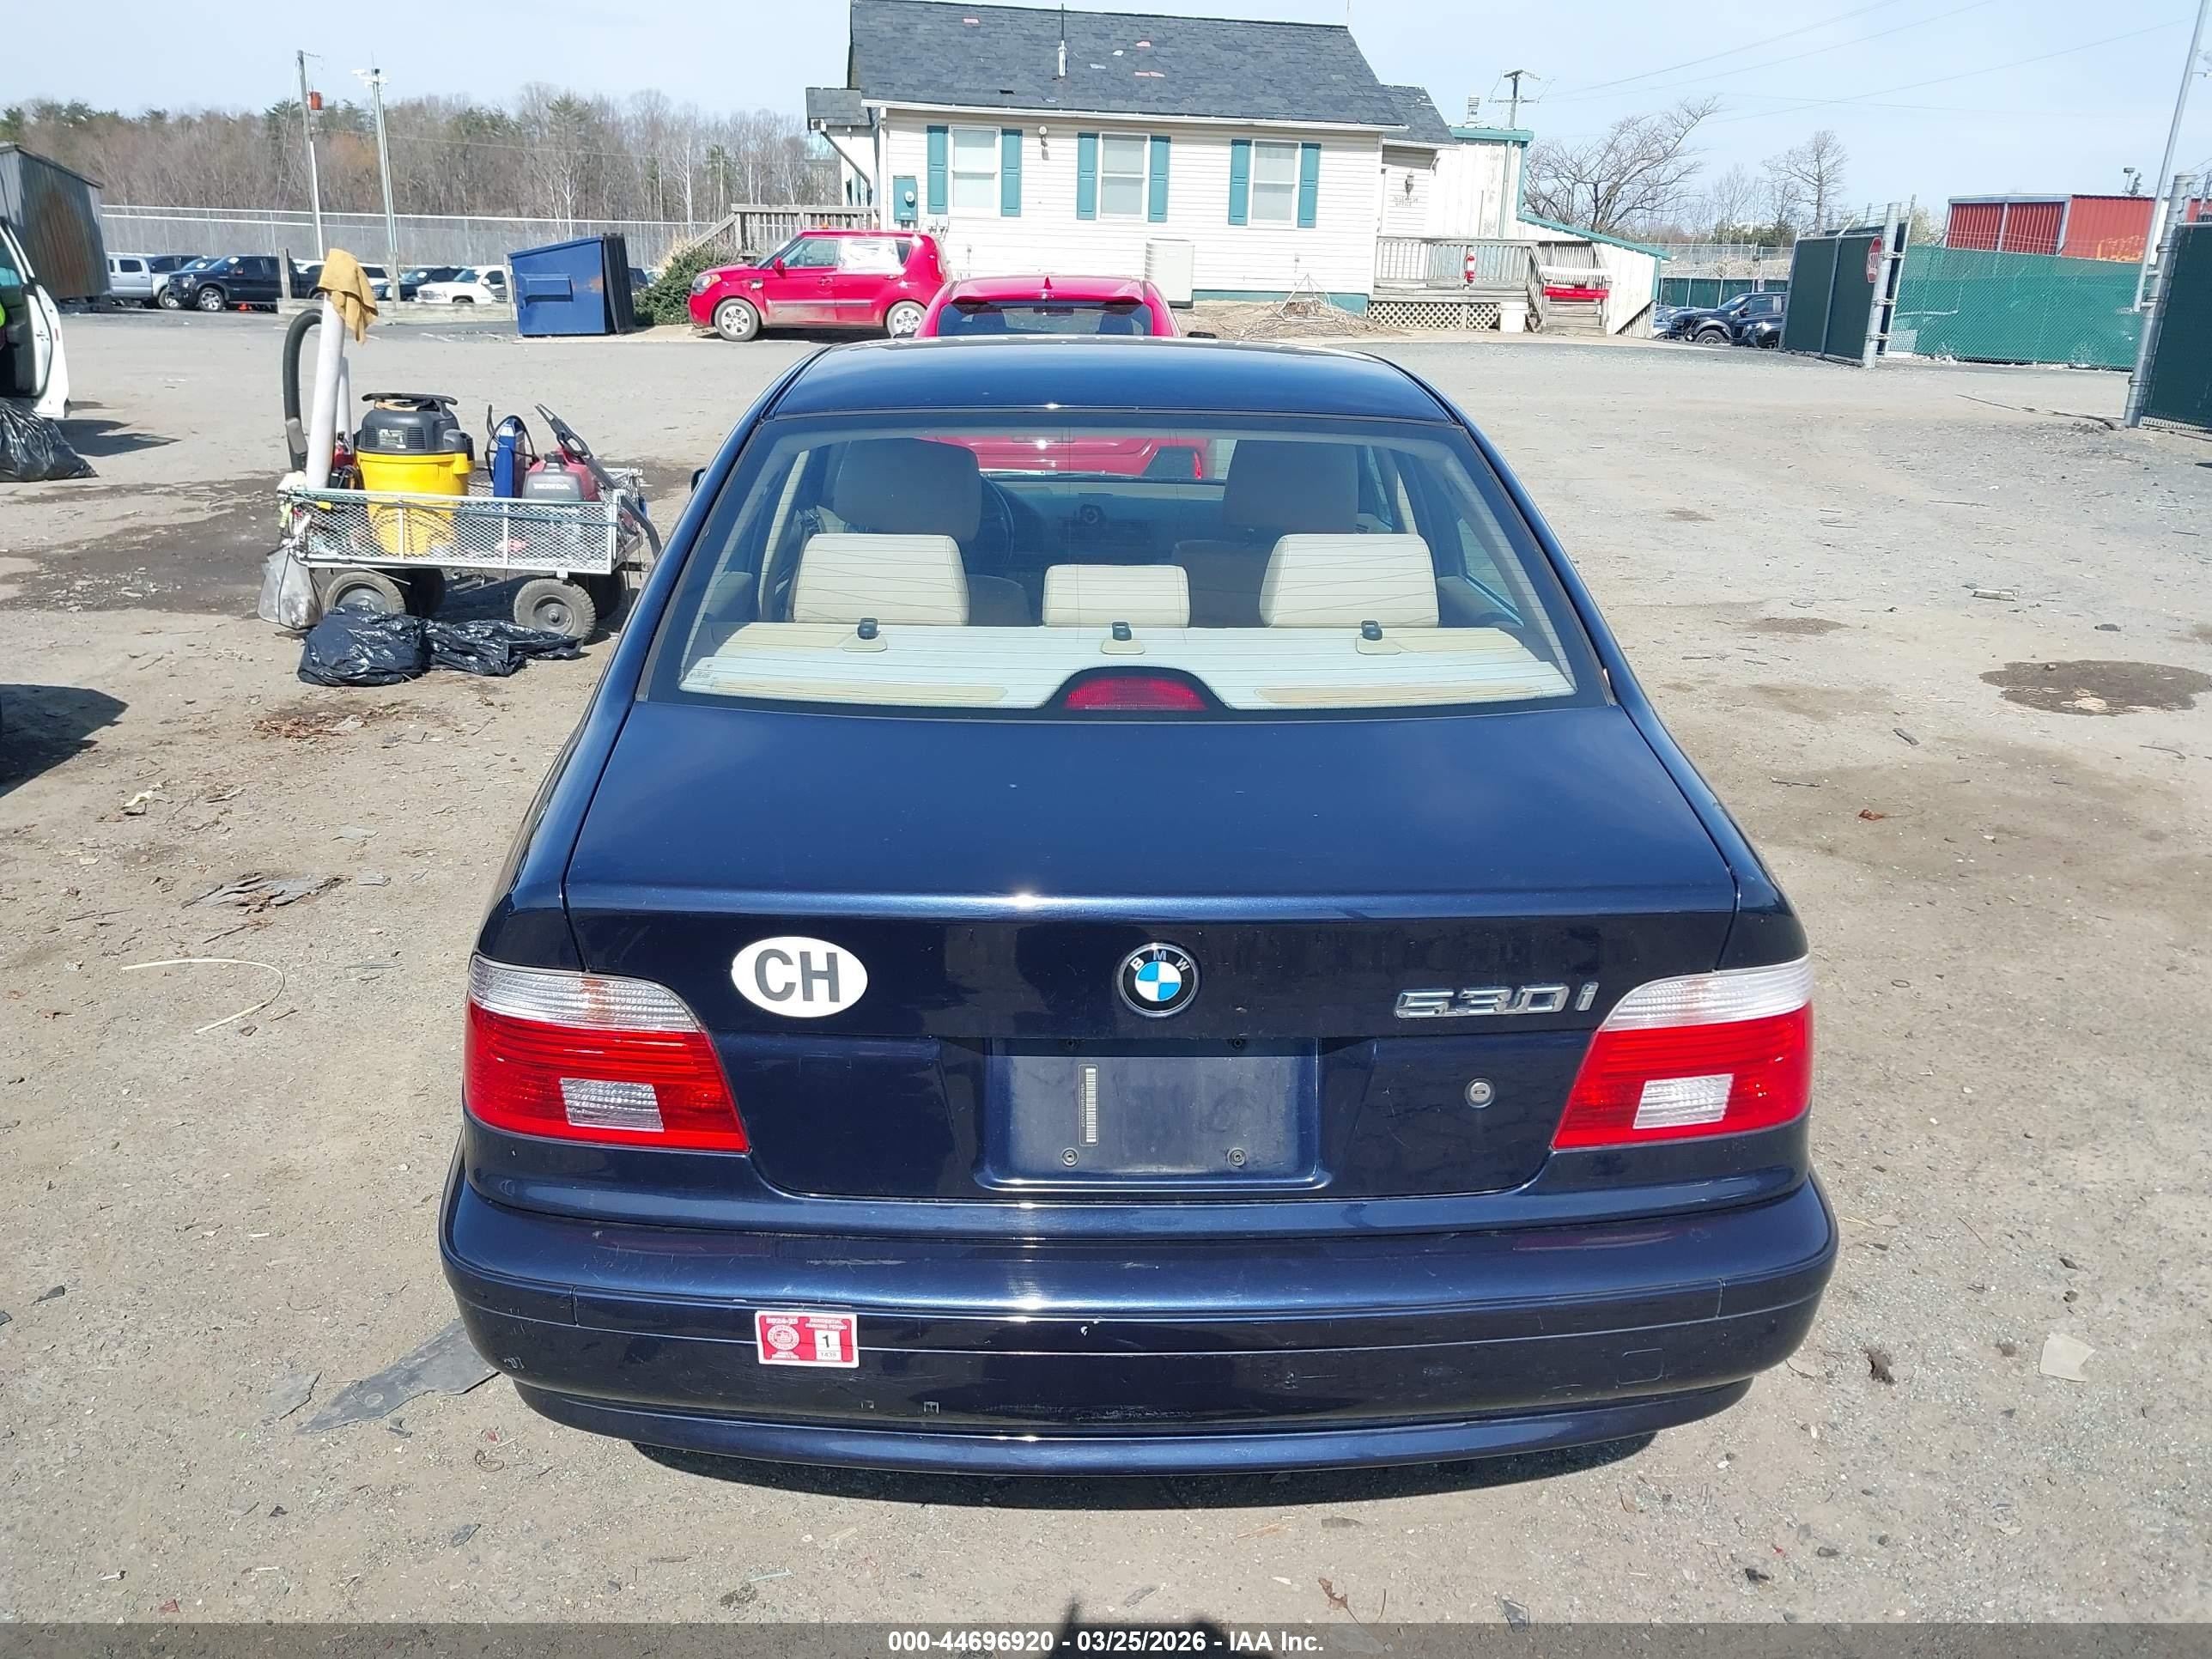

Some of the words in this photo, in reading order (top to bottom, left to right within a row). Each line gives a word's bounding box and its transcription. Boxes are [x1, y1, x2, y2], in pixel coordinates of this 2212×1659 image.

[754, 948, 841, 1003] CH
[1130, 950, 1190, 972] BMW
[1395, 981, 1600, 1019] 530i
[822, 1334, 830, 1348] 1
